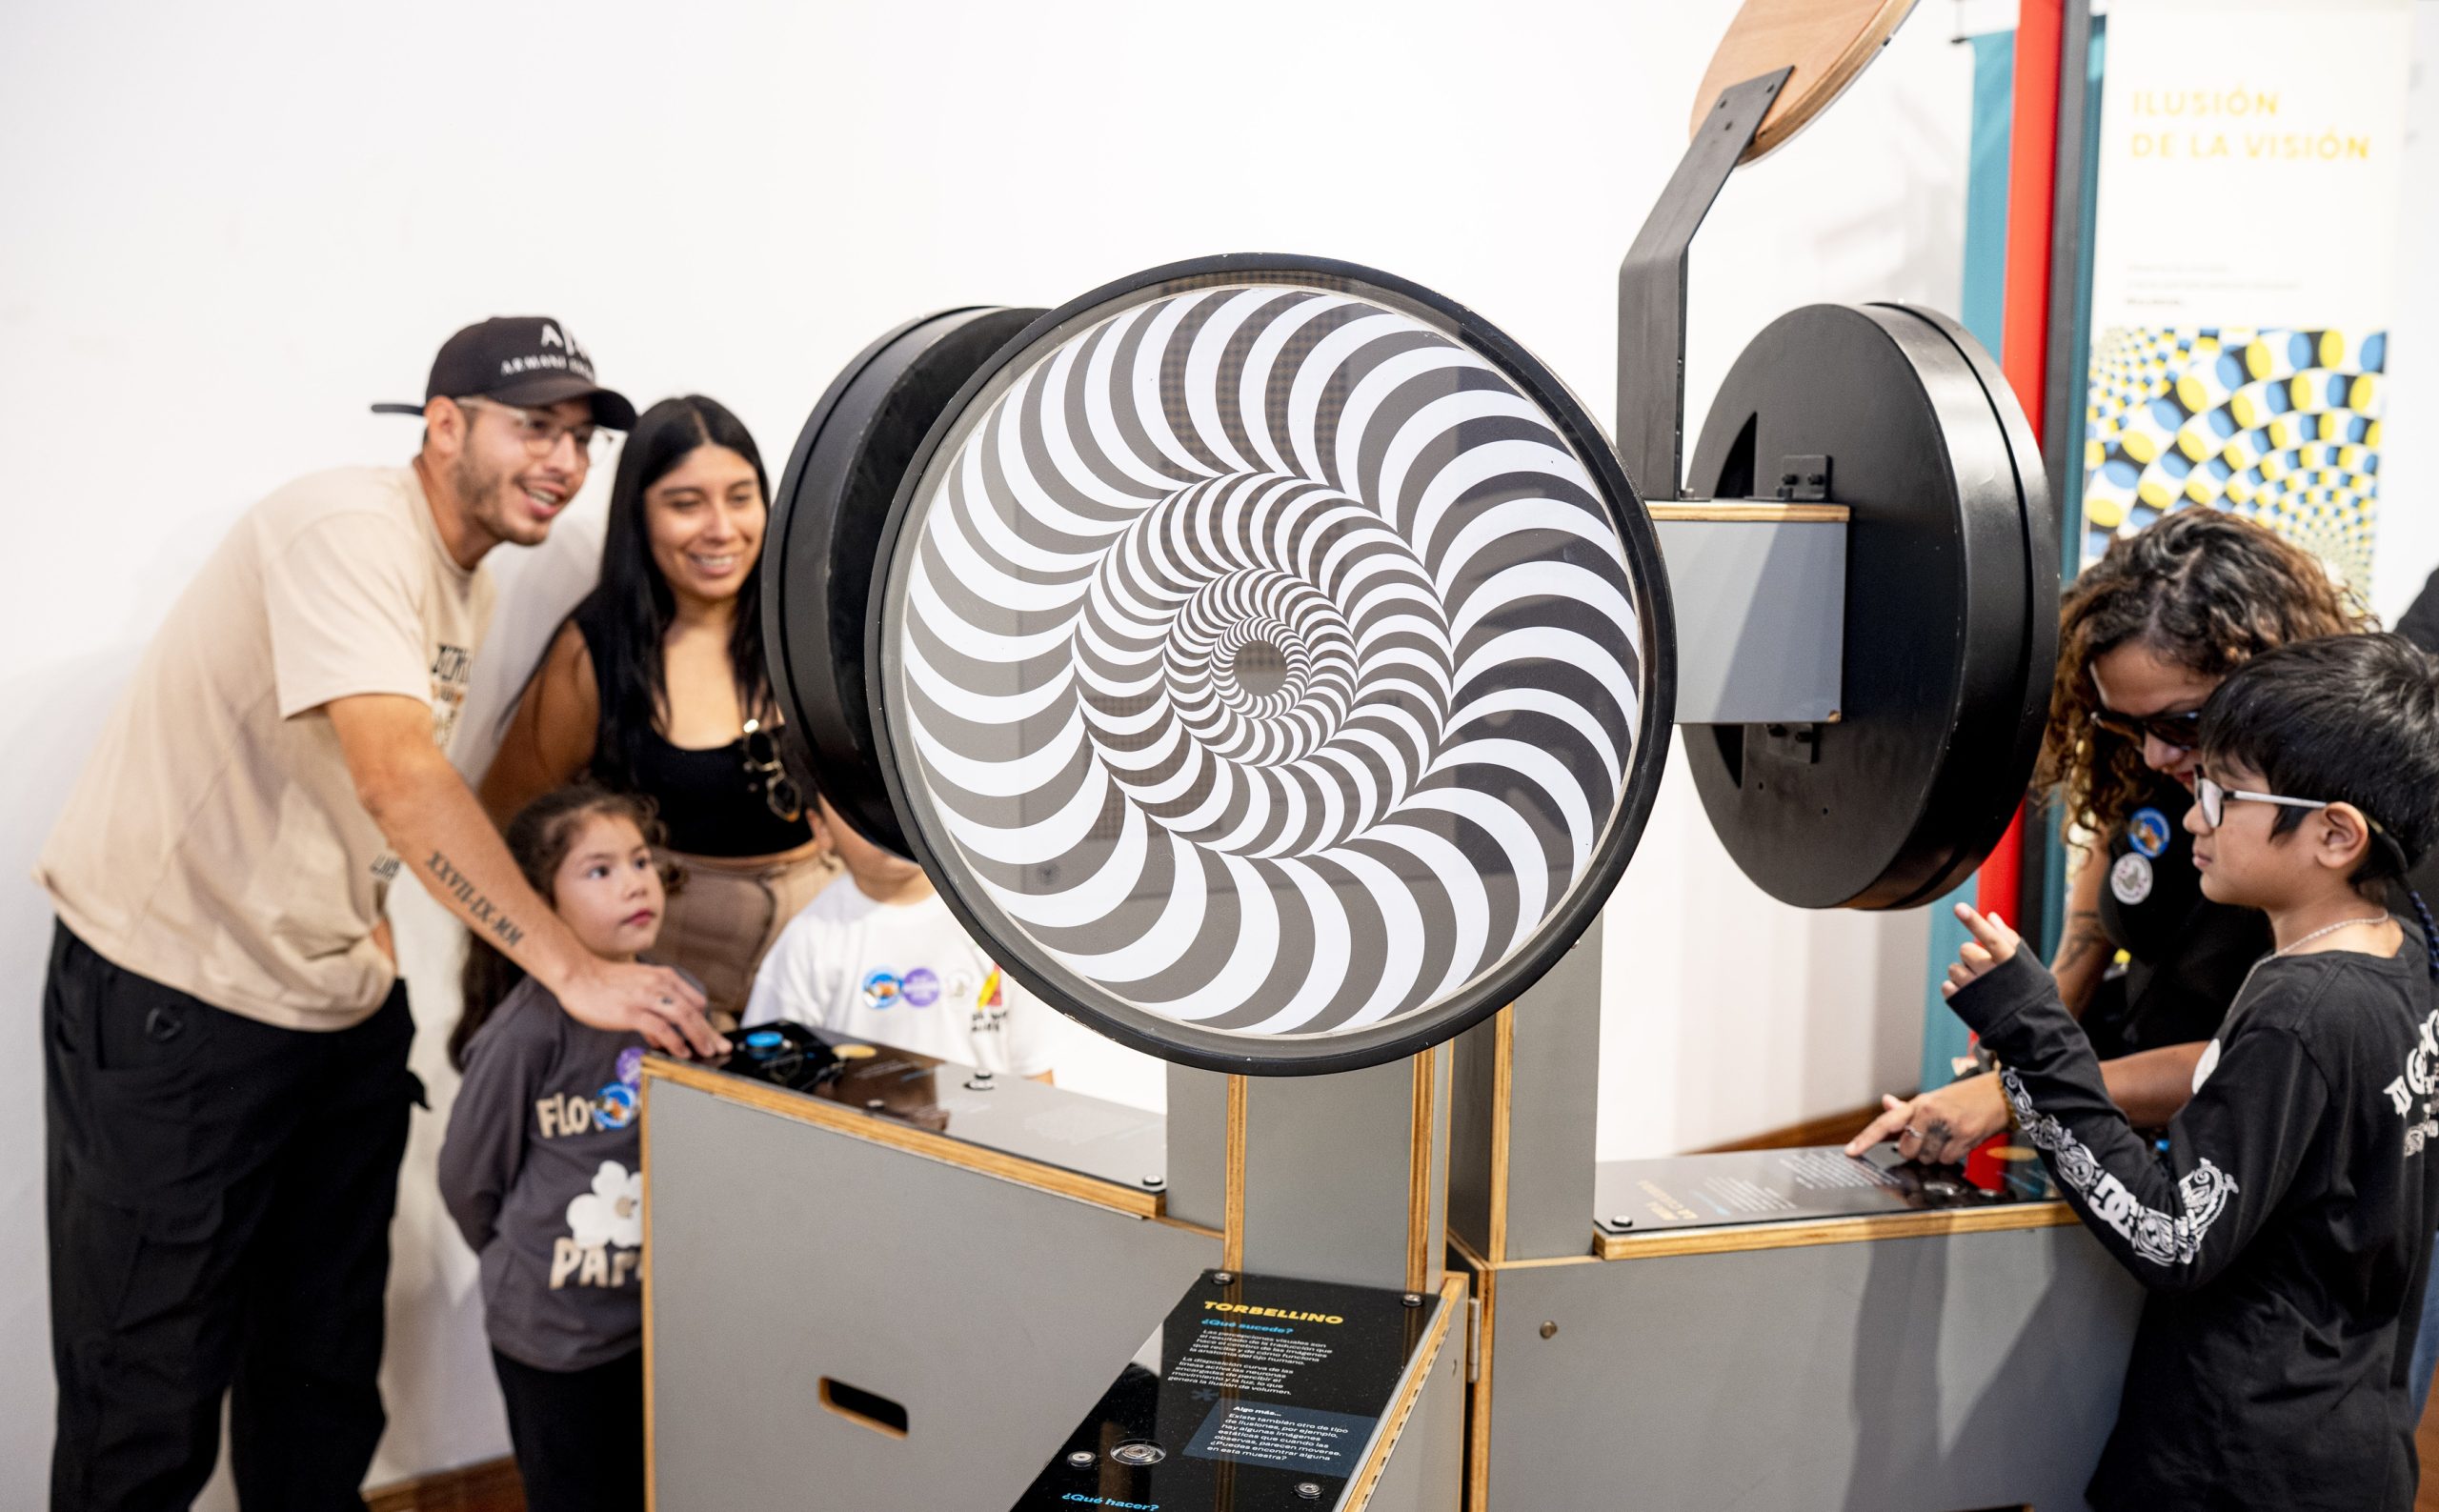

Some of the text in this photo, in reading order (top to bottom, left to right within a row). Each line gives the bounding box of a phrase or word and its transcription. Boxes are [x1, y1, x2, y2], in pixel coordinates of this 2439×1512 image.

[2131, 82, 2280, 116] ILUSIÓN
[2130, 124, 2370, 161] DE LA VISIÓN
[1204, 1300, 1343, 1324] TORBELLINO
[1201, 1319, 1294, 1334] ¿Qué sucede?
[1218, 1332, 1275, 1341] percepciones
[1209, 1335, 1248, 1343] resultado
[1270, 1342, 1315, 1352] traducción
[1282, 1353, 1320, 1362] funciona
[1286, 1349, 1327, 1359] imágenes
[1194, 1358, 1242, 1367] disposición
[1268, 1357, 1305, 1365] humano.
[1175, 1366, 1224, 1376] encargadas
[1246, 1370, 1286, 1379] neuronas
[1172, 1372, 1224, 1381] movimiento
[1252, 1386, 1291, 1395] volumen.
[1258, 1417, 1296, 1426] también
[1239, 1420, 1280, 1430] ilusiones,
[1300, 1429, 1338, 1438] ejemplo,
[1218, 1429, 1260, 1439] estáticas
[1280, 1438, 1315, 1446] cuando
[1276, 1431, 1320, 1441] imágenes
[1210, 1441, 1251, 1450] ¿Puedes
[1252, 1446, 1299, 1456] encontrar
[1214, 1435, 1341, 1457] observas, parecen moverse.
[1242, 1451, 1287, 1461] muestra?
[1061, 1492, 1159, 1511] ¿Qué hacer?
